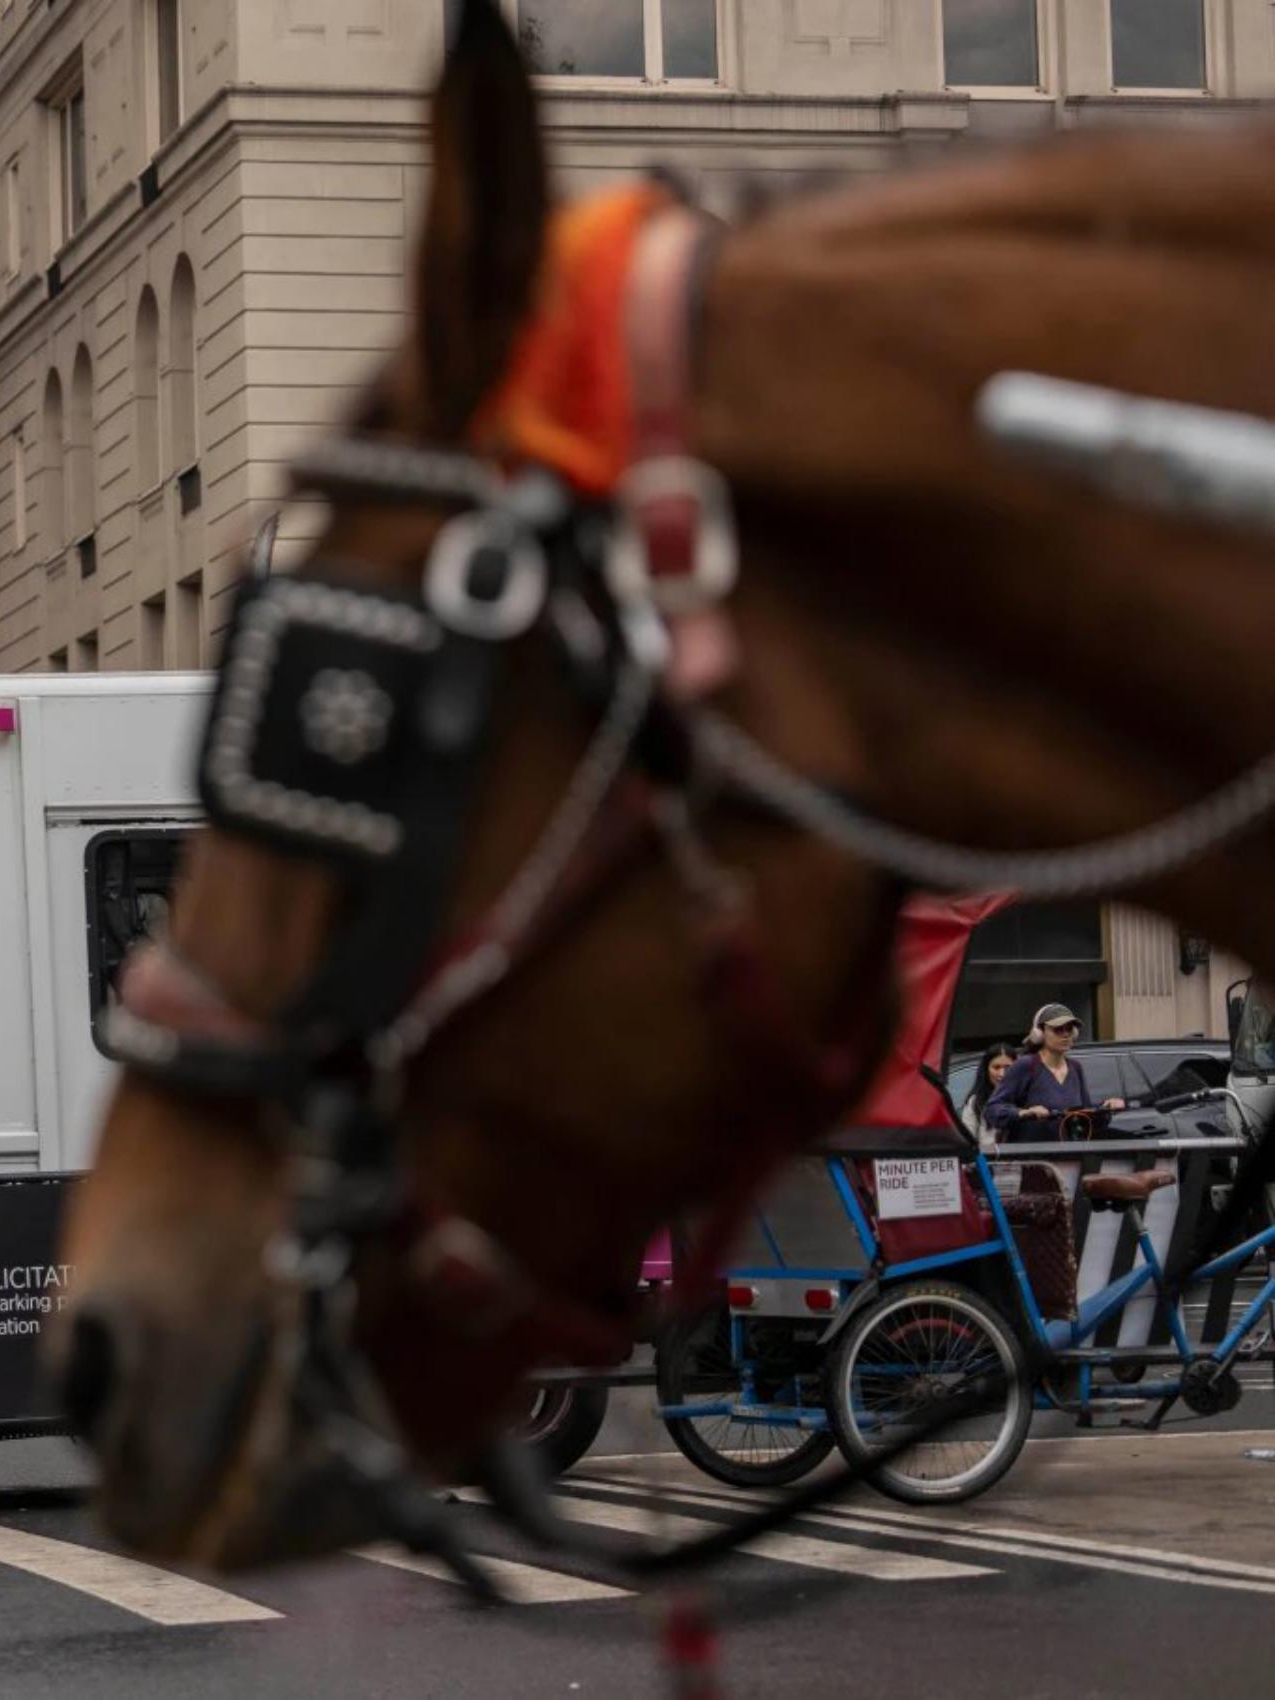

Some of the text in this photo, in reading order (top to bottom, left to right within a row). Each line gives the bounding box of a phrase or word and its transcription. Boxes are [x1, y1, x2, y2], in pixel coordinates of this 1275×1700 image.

[878, 1160, 955, 1177] MINUTE PER
[879, 1177, 910, 1191] RIDE
